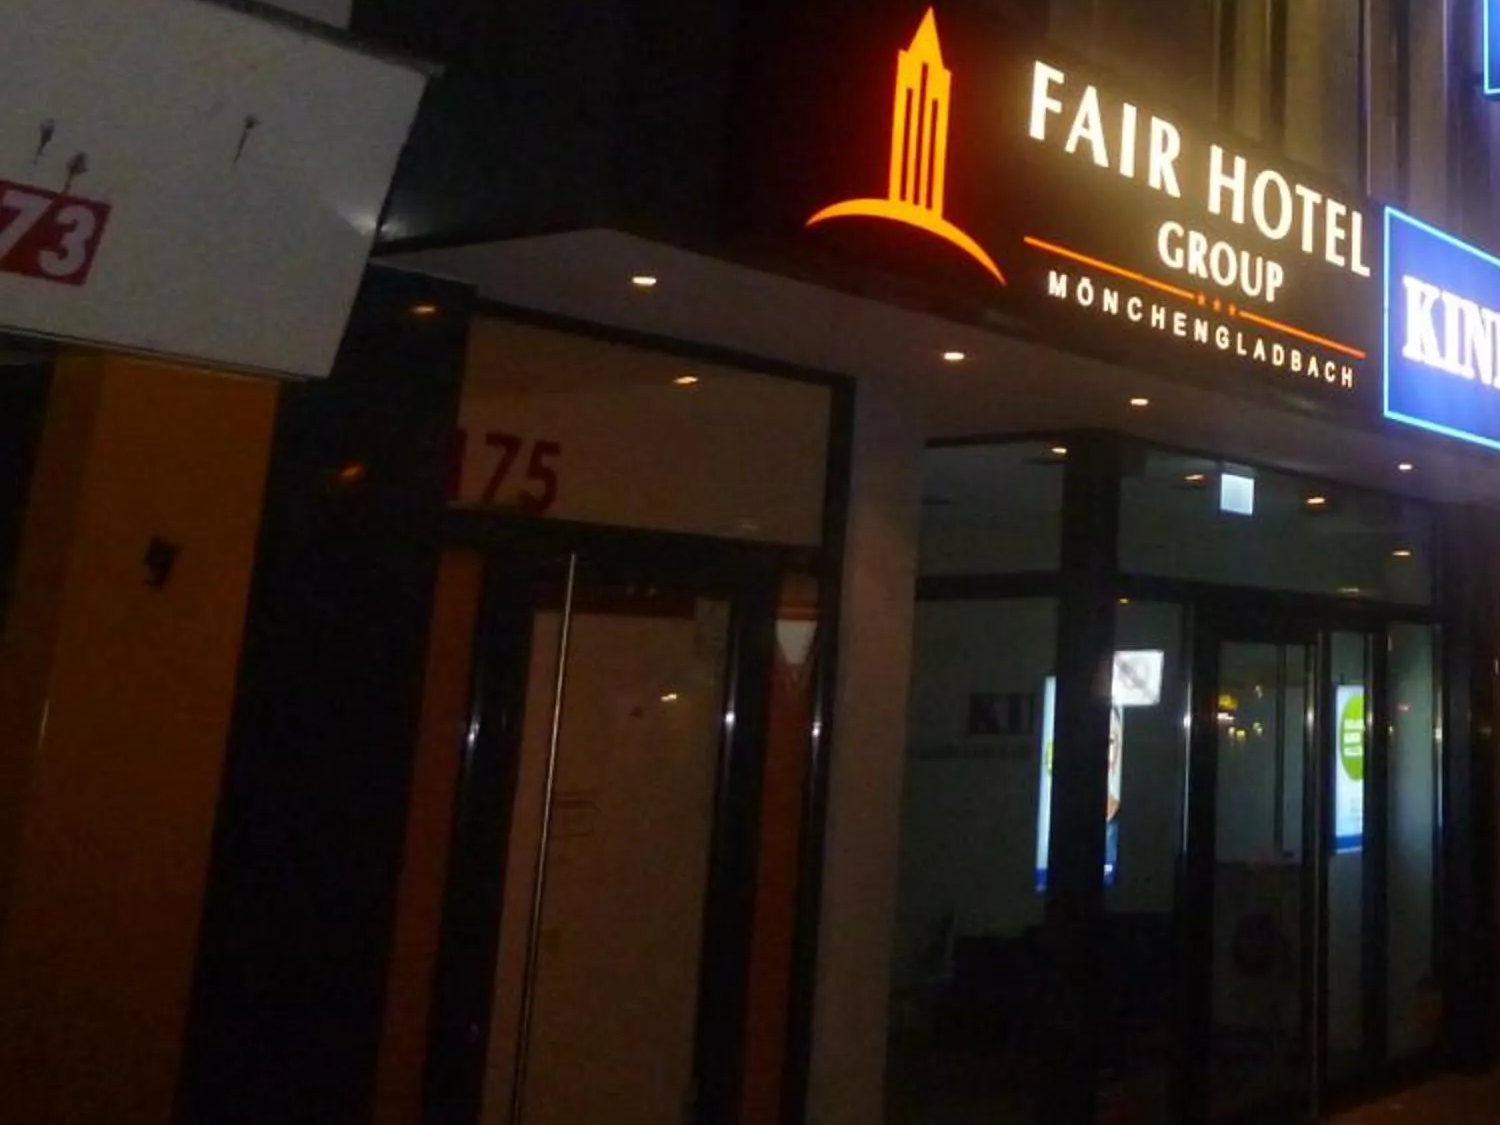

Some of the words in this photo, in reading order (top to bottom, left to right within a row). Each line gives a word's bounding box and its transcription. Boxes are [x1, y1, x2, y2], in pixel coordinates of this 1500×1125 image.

[1029, 60, 1181, 198] FAIR
[1207, 144, 1371, 277] HOTEL
[1157, 221, 1284, 302] GROUP
[1048, 270, 1354, 388] MÖNCHENGLADBACH
